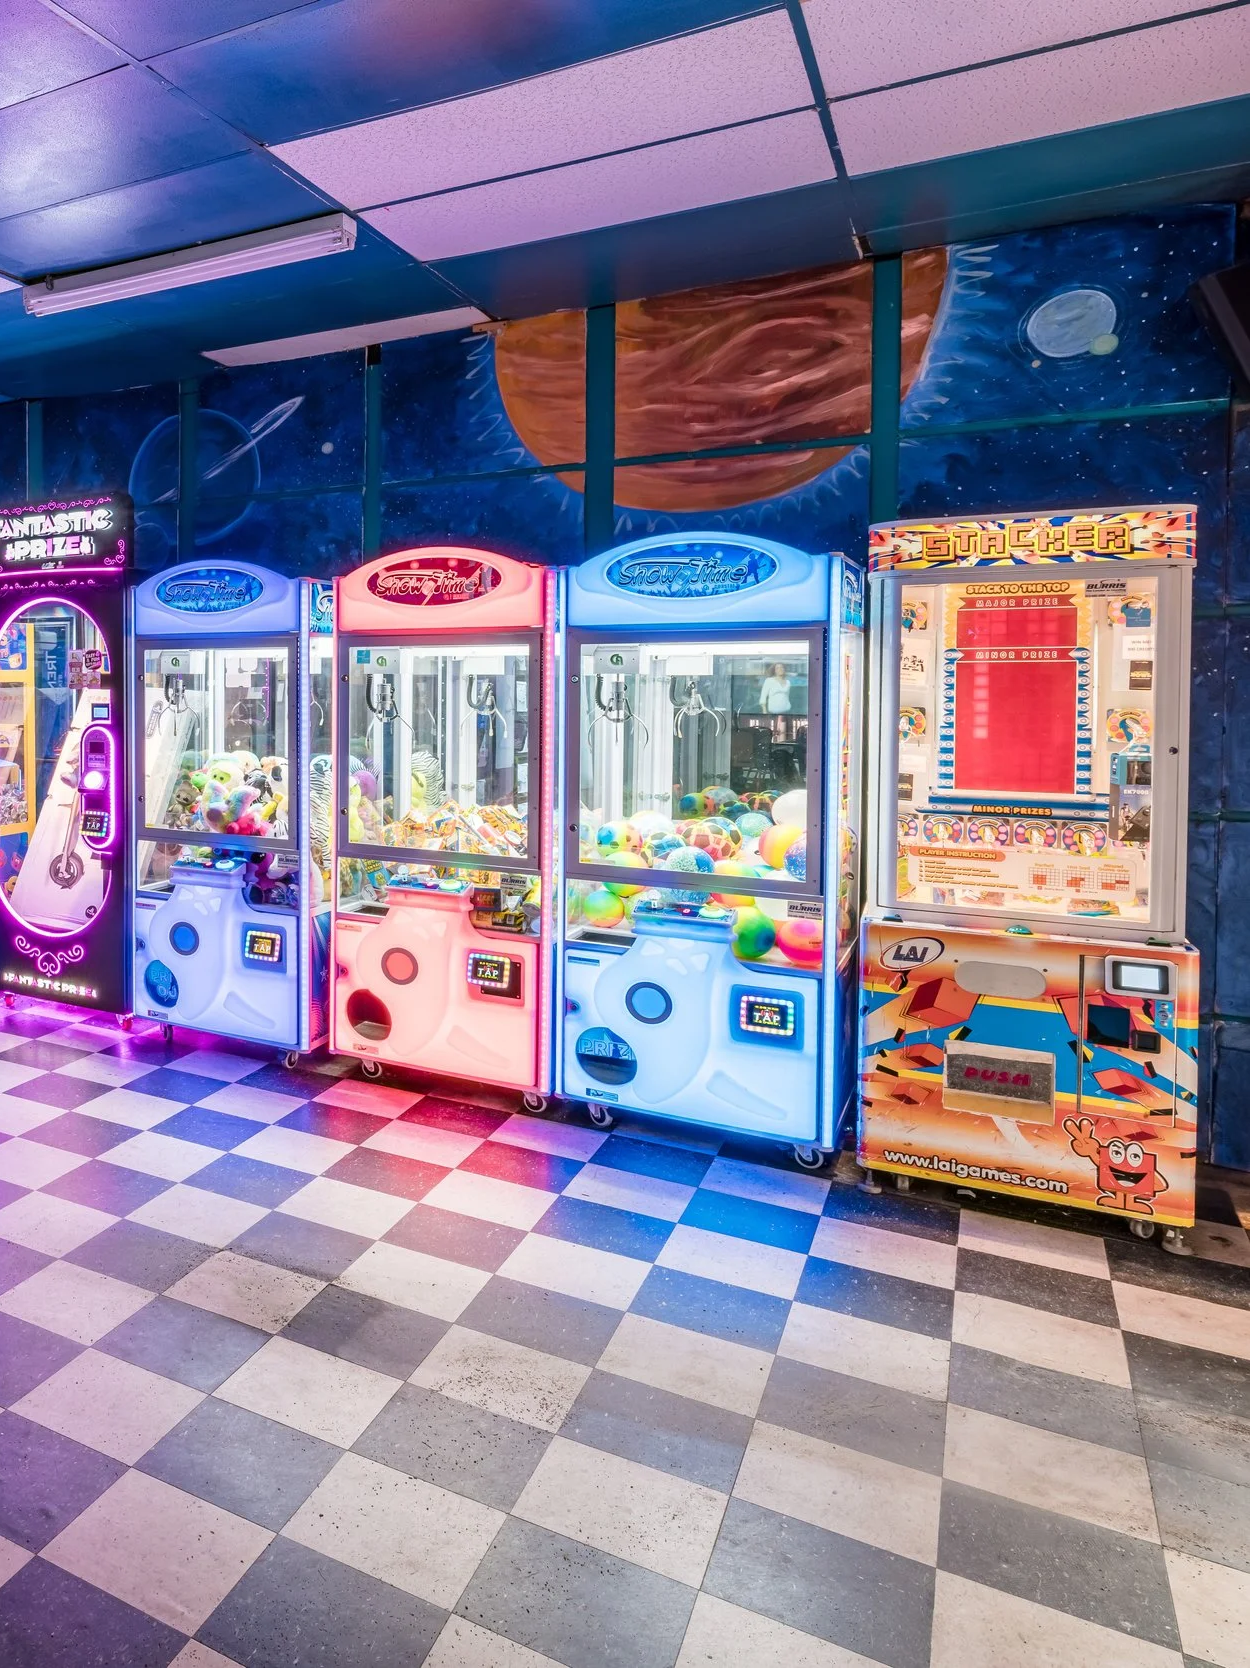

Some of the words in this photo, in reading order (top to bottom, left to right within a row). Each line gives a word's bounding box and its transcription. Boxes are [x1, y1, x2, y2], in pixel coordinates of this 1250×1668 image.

[14, 536, 81, 560] PRIZE
[923, 523, 1131, 560] STACKER
[966, 583, 1003, 595] STACK
[1003, 583, 1020, 594] TO
[1021, 583, 1045, 594] THE
[1045, 582, 1070, 593] TOP
[975, 599, 1016, 608] MAJOR
[1022, 598, 1058, 607] PRIZE
[975, 650, 1016, 659] MINOR
[1022, 650, 1058, 659] PRIZE
[972, 804, 1011, 815] MINOR
[1013, 806, 1052, 817] PRIZES
[918, 848, 945, 856] PLAYER
[946, 850, 996, 860] INSTRUCTION
[892, 945, 930, 963] LAI
[478, 967, 499, 977] TAP
[753, 1012, 781, 1024] TAP
[963, 1065, 1031, 1087] PUSH
[883, 1148, 1069, 1194] www.laigames.com
